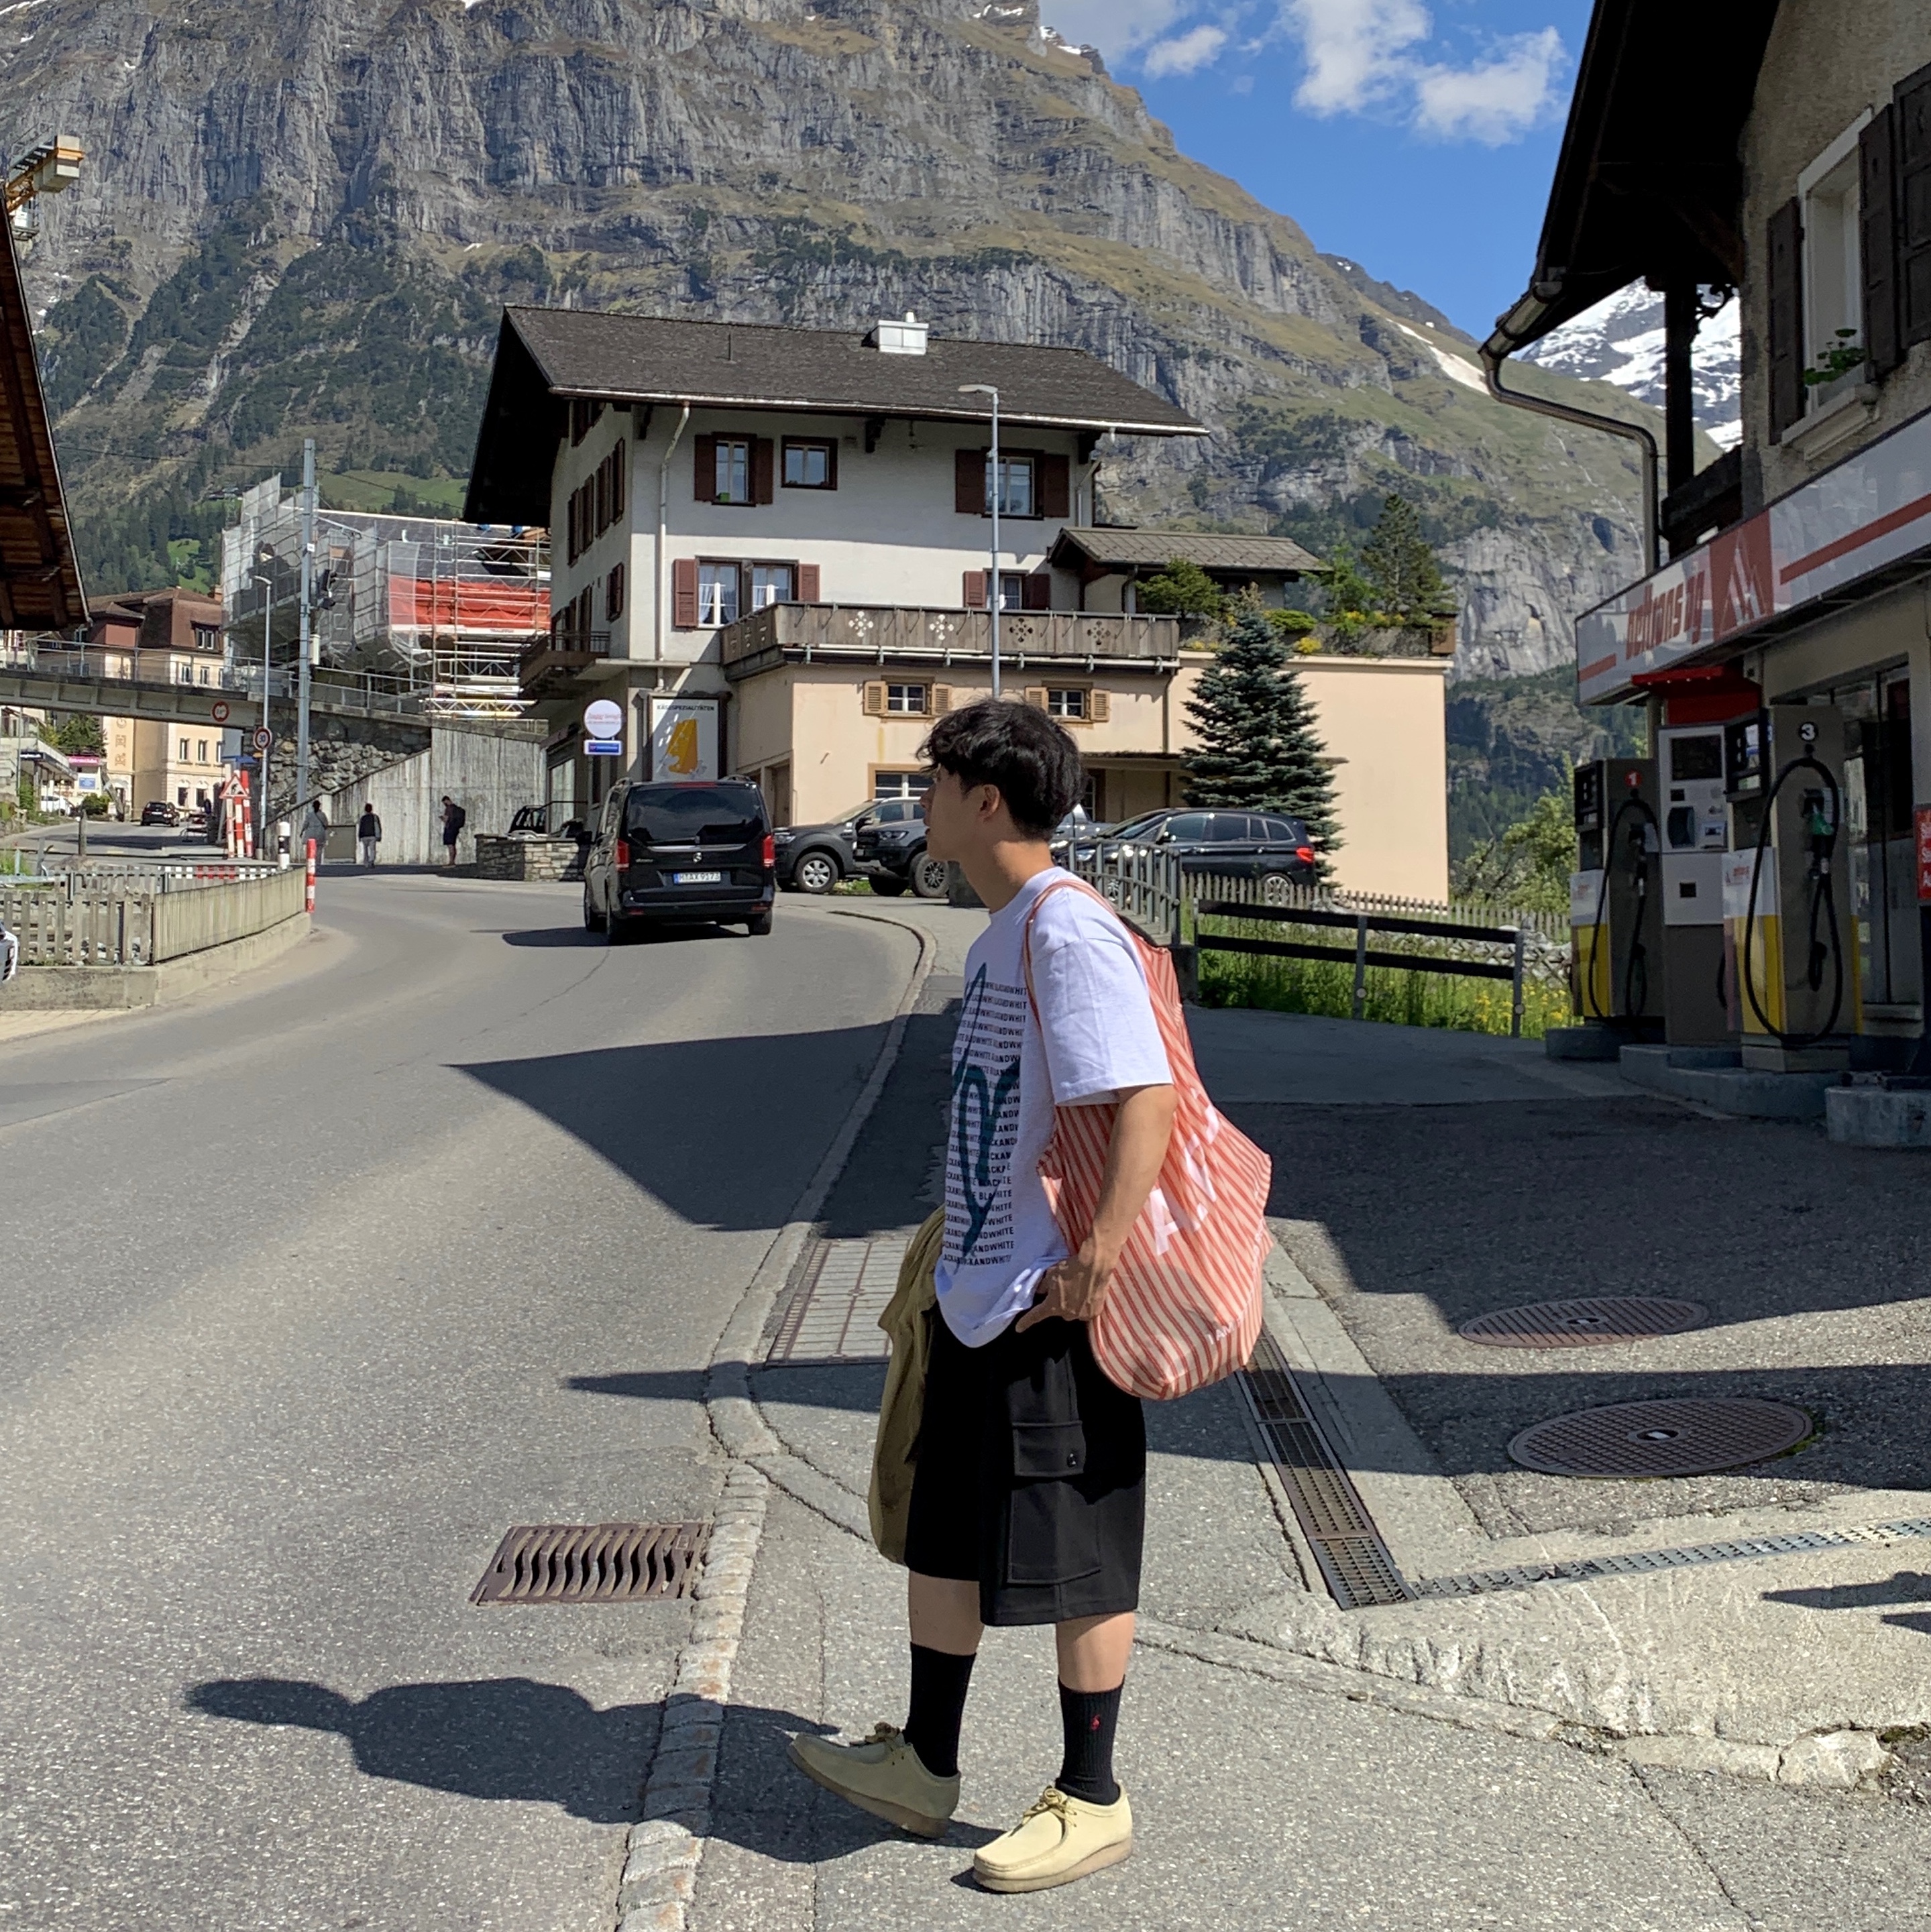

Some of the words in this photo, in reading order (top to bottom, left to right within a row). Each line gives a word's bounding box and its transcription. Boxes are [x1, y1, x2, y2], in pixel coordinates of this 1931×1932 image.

[1800, 723, 1815, 740] 3
[259, 734, 267, 744] 30
[1629, 772, 1637, 786] 1
